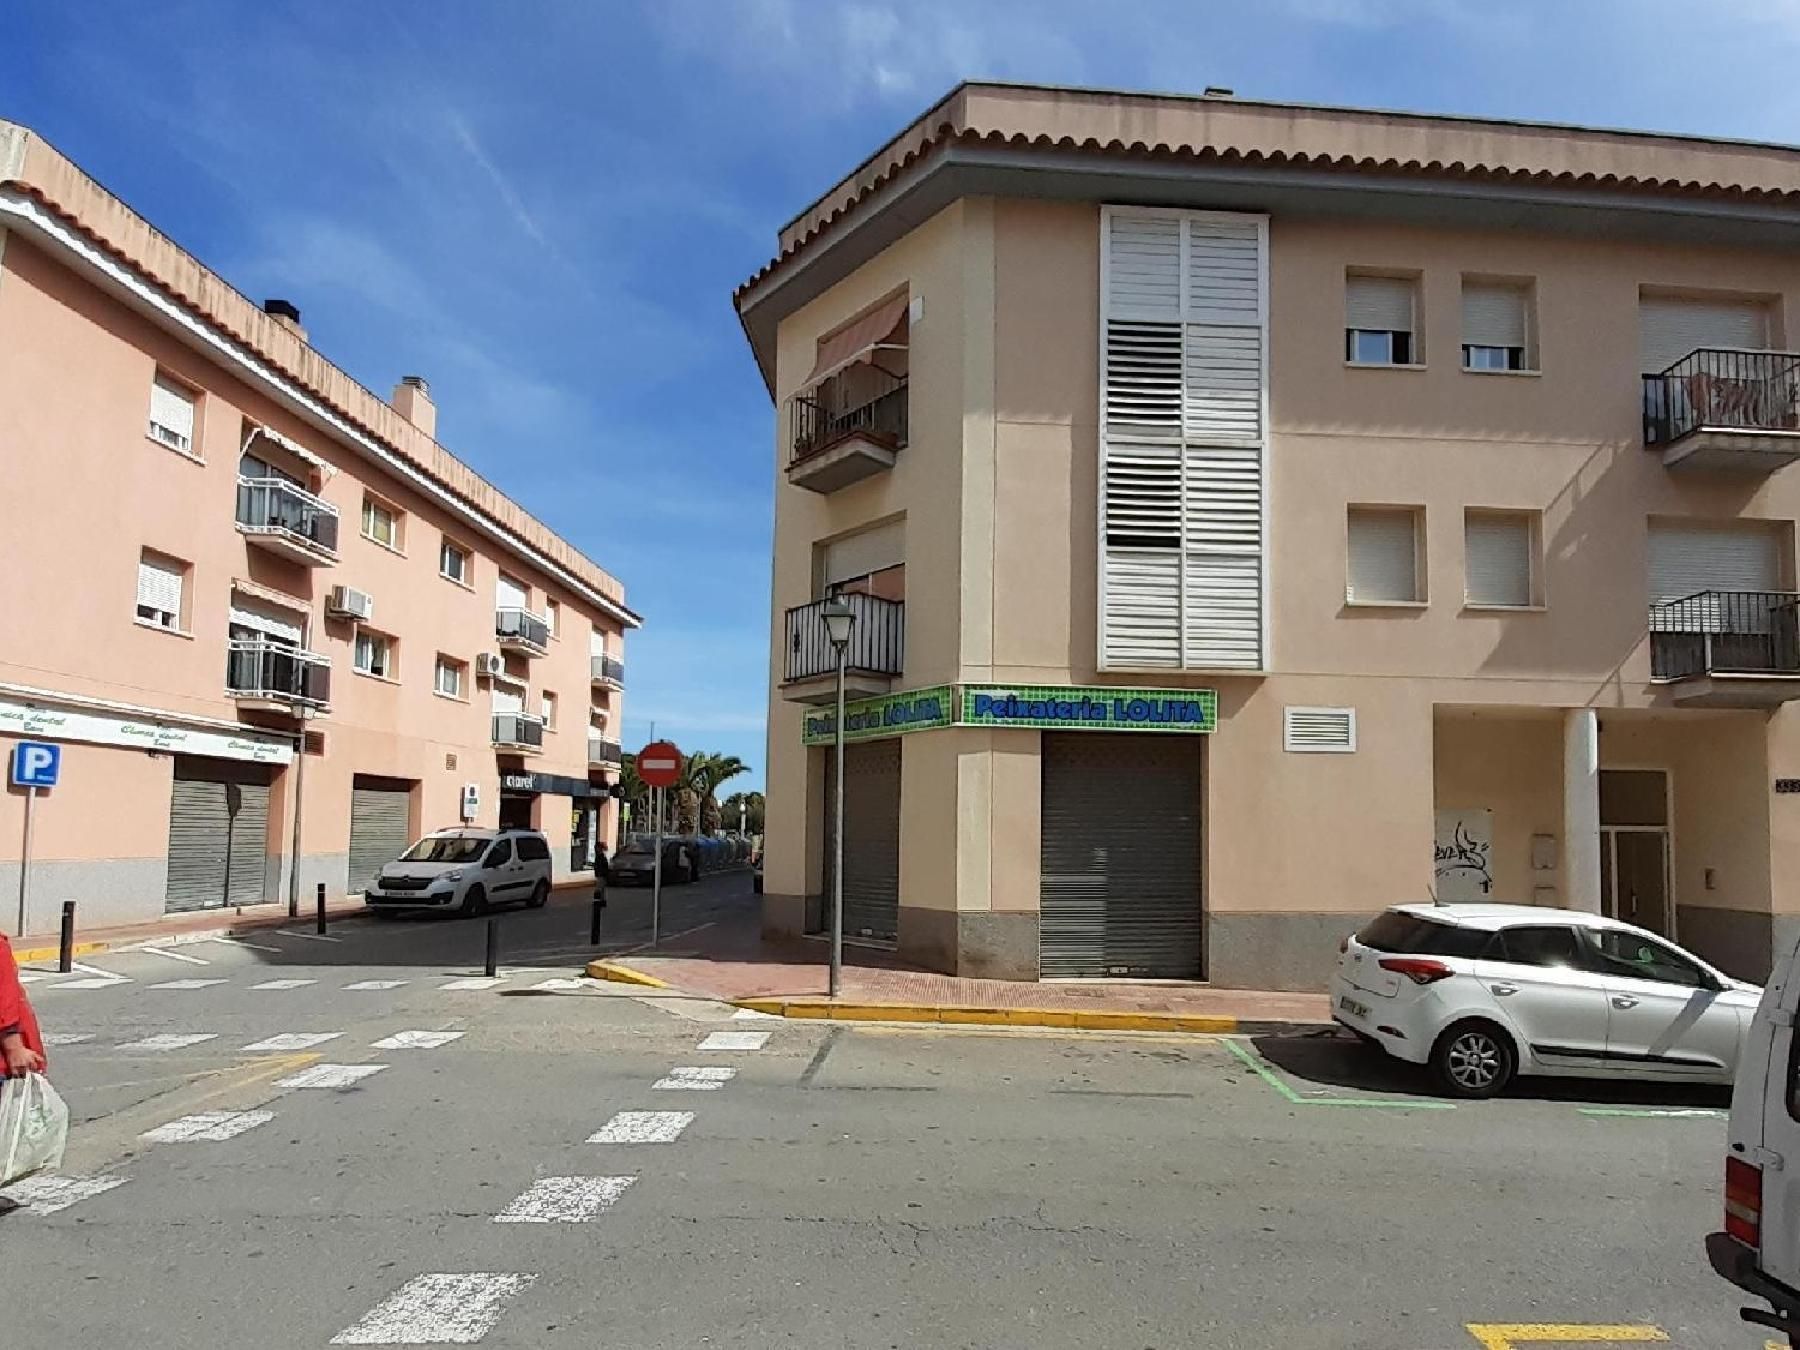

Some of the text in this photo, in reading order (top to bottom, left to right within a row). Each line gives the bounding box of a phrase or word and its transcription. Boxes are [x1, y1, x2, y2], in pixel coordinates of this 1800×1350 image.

[807, 707, 880, 736] Peixteria
[975, 694, 1204, 722] Peixateria LOLITA
[24, 747, 53, 779] P
